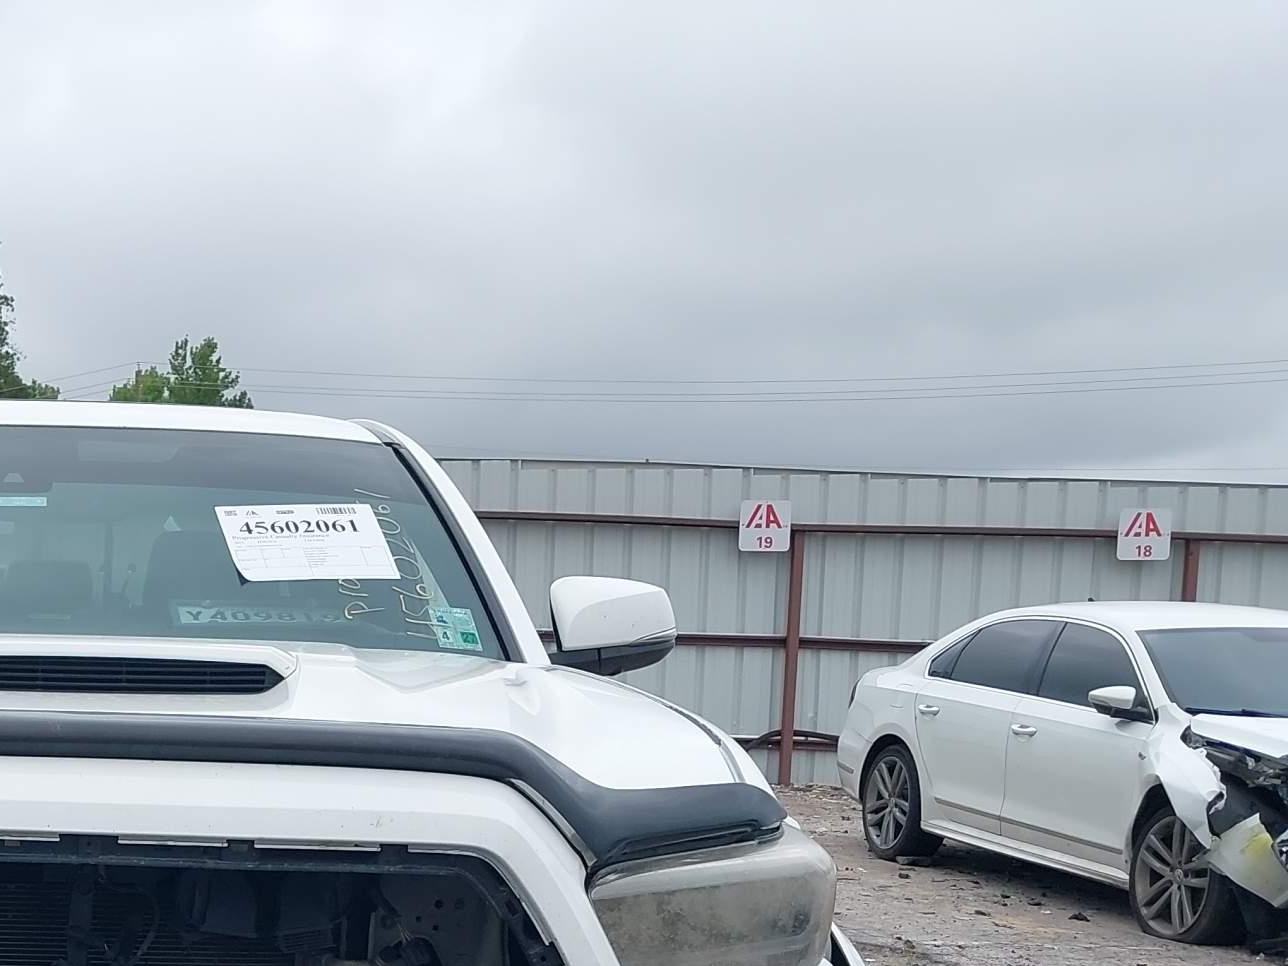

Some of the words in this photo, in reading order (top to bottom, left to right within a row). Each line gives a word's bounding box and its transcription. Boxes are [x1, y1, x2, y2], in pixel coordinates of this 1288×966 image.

[240, 519, 361, 535] 45602061
[756, 536, 773, 549] 19
[1135, 545, 1153, 558] 18
